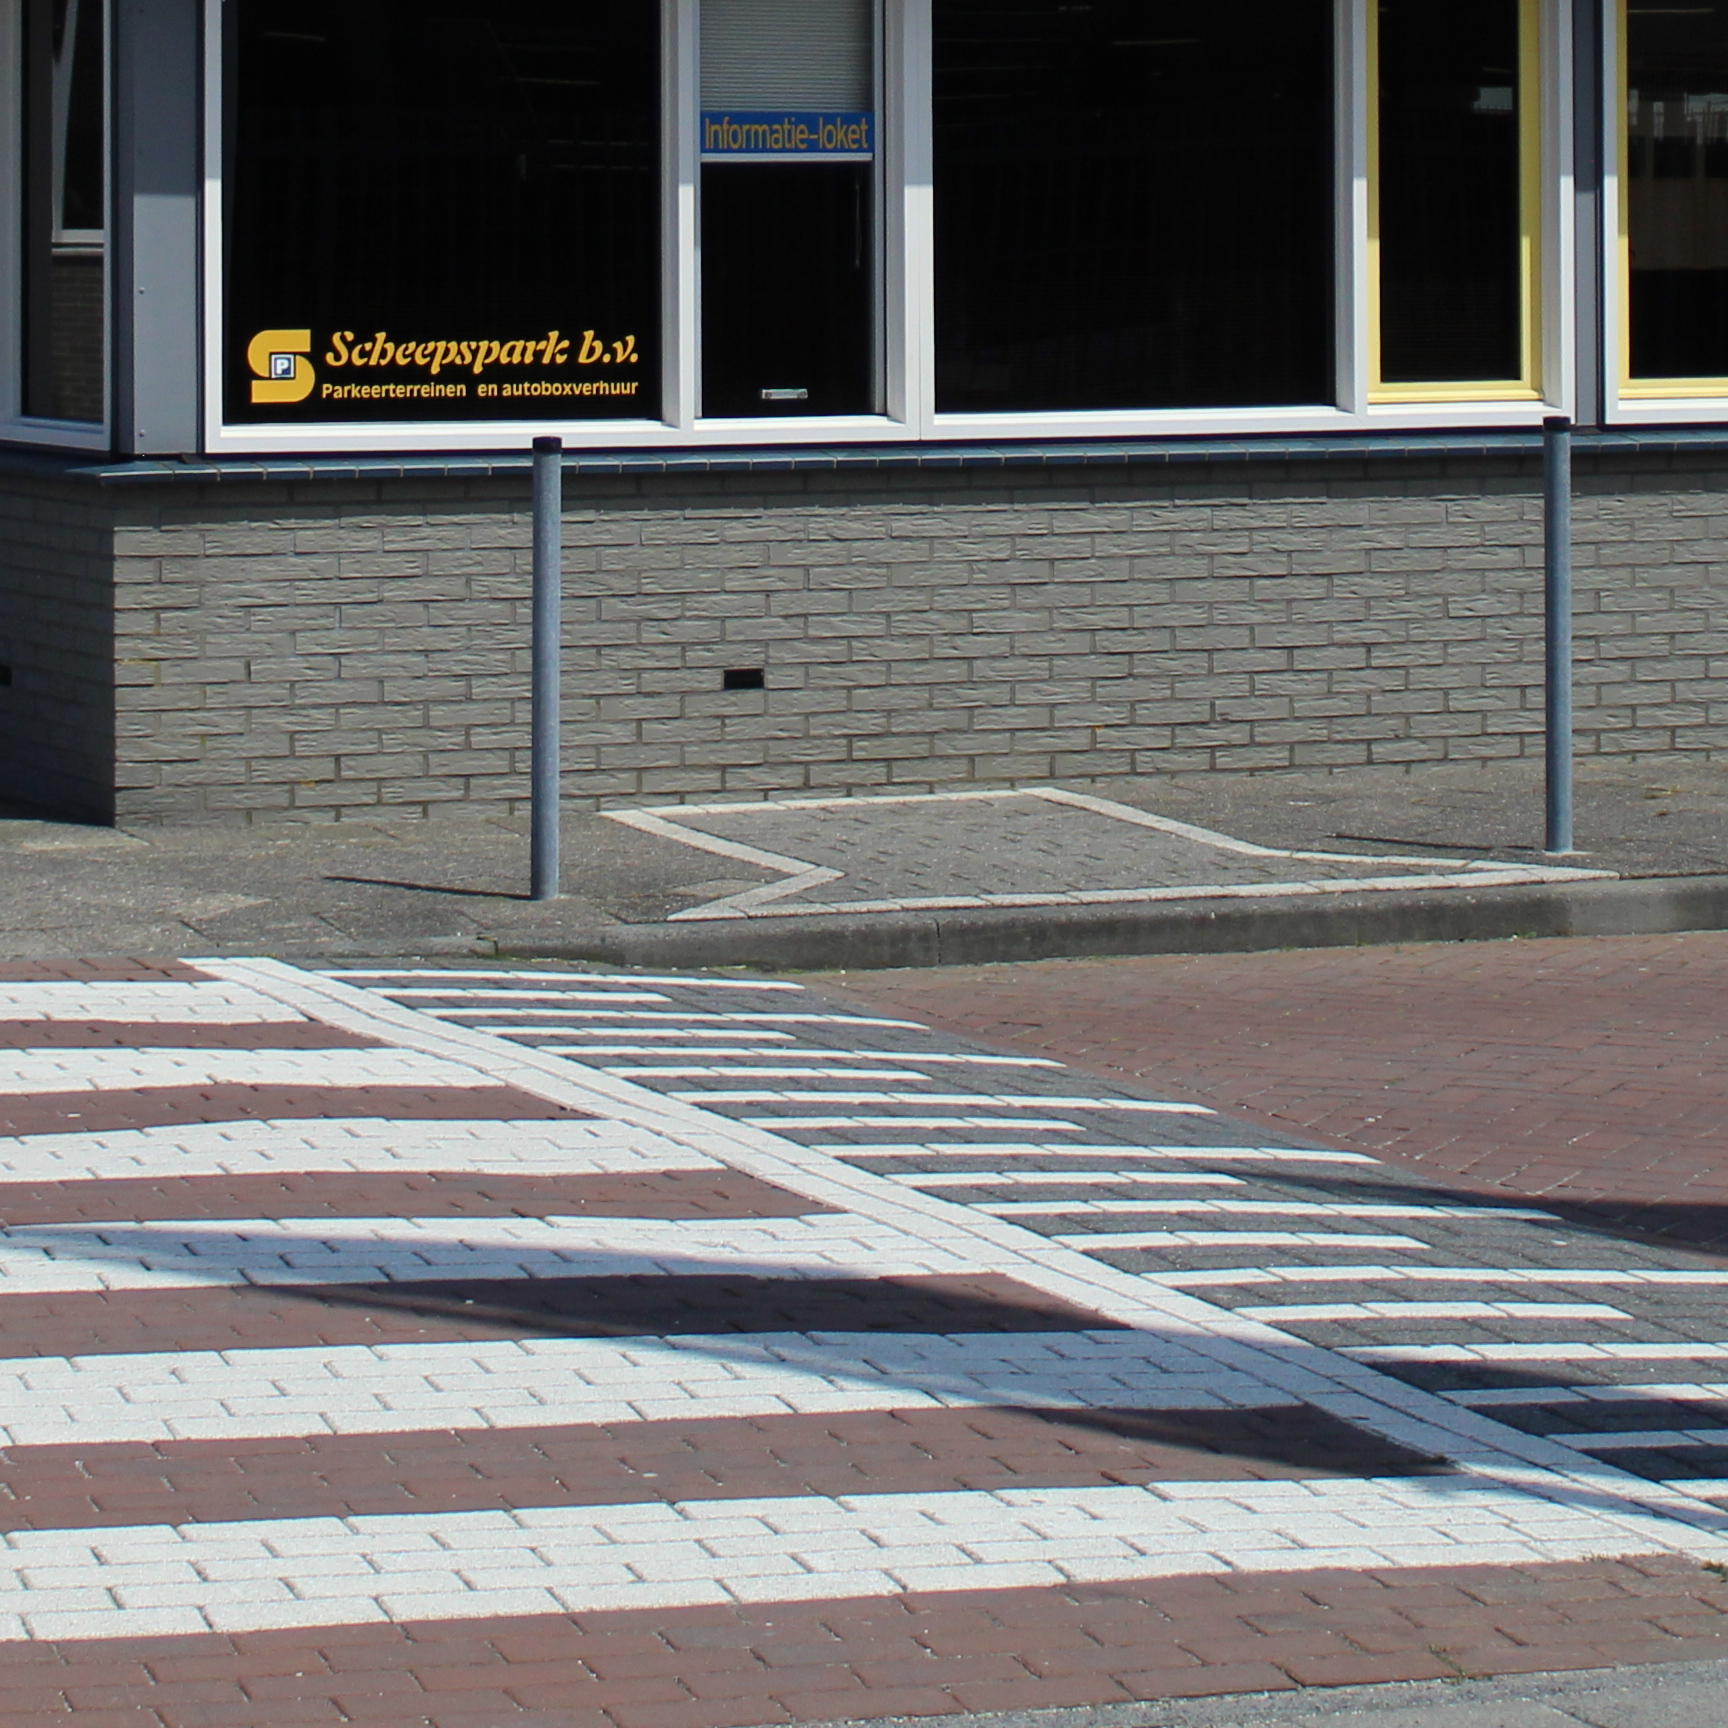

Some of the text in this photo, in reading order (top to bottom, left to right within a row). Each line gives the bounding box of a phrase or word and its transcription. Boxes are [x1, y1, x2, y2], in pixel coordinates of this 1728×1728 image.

[704, 116, 869, 150] Informatie-loket
[325, 330, 639, 374] Scheepspark b.v.
[322, 380, 639, 399] Parkeerterreinen en autoboxverhuur
